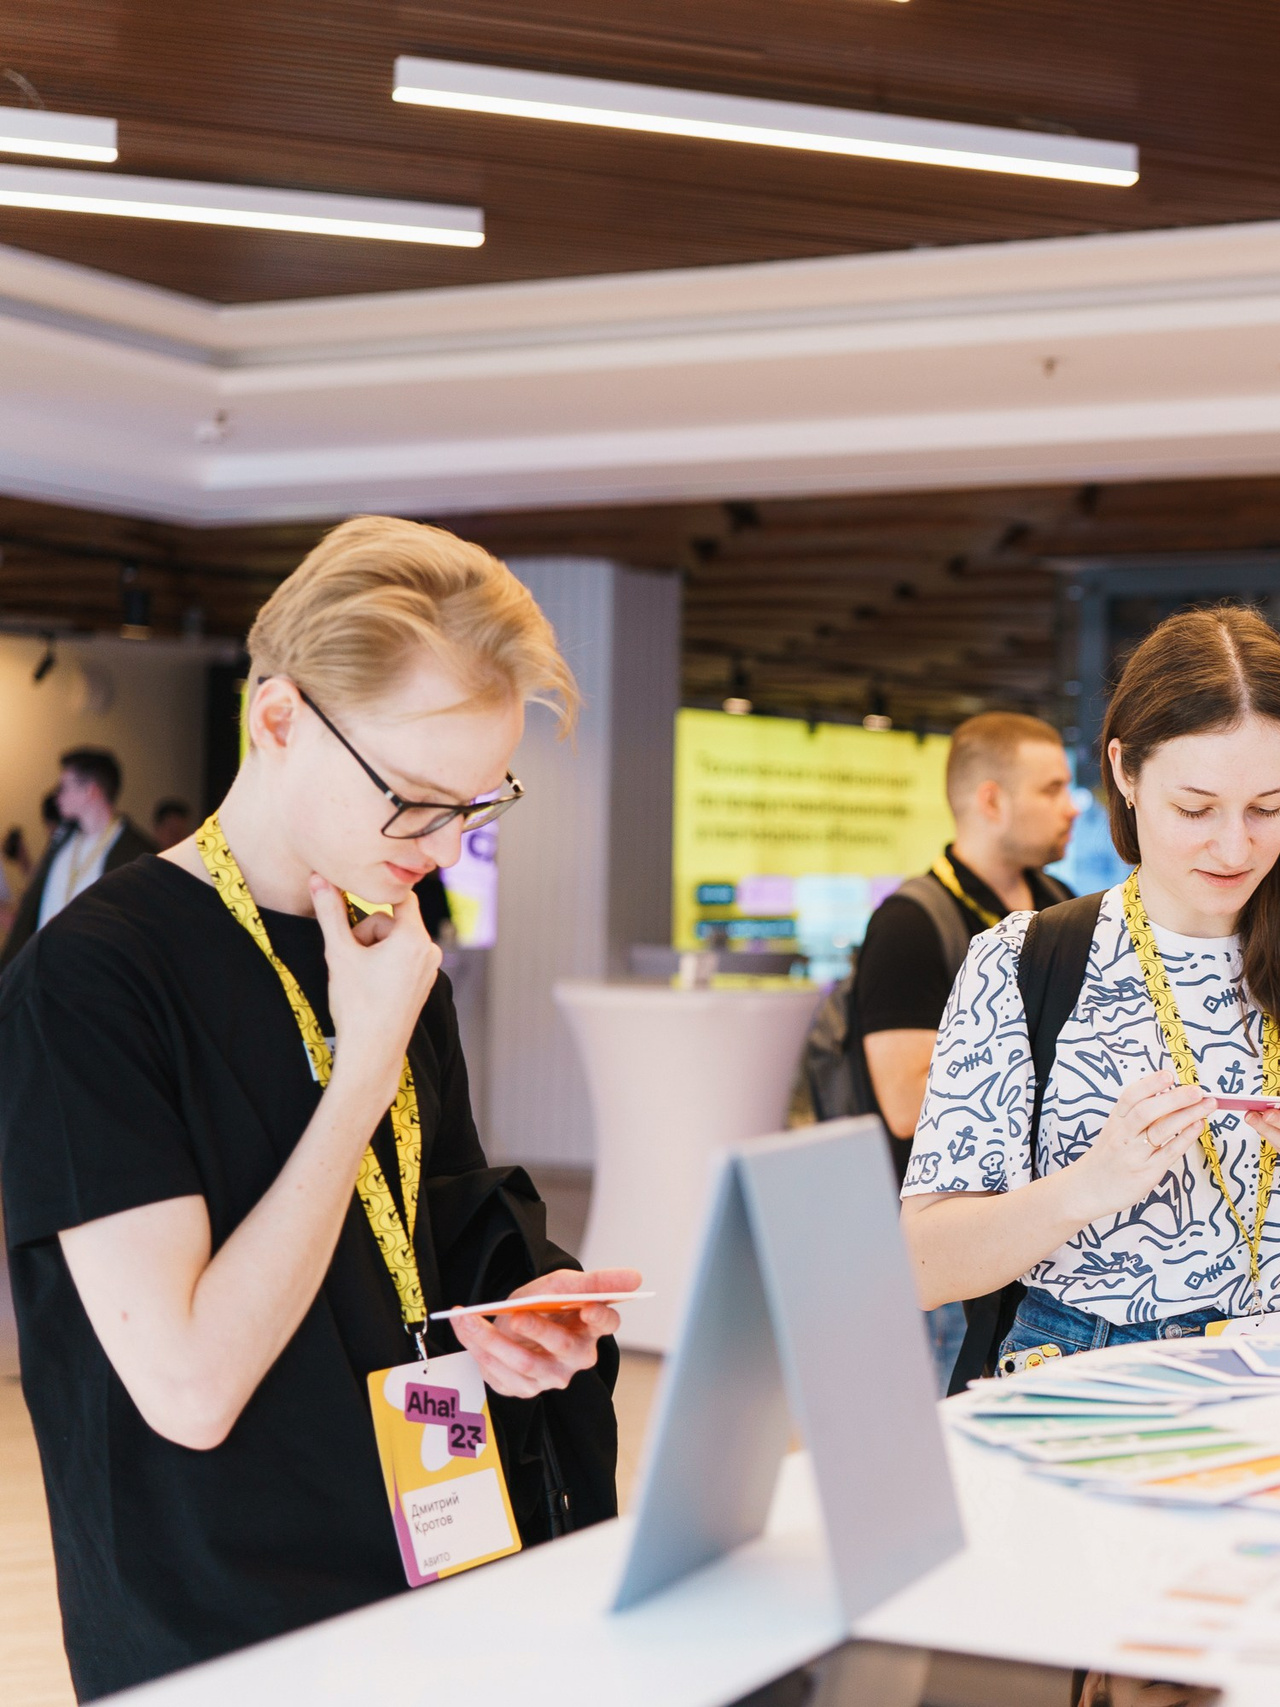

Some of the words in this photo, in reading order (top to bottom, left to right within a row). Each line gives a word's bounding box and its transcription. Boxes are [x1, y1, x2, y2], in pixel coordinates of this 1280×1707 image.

[407, 1391, 456, 1419] Aha!
[450, 1423, 483, 1451] 23
[411, 1491, 460, 1520] Дмитрий
[414, 1515, 454, 1536] Кротов
